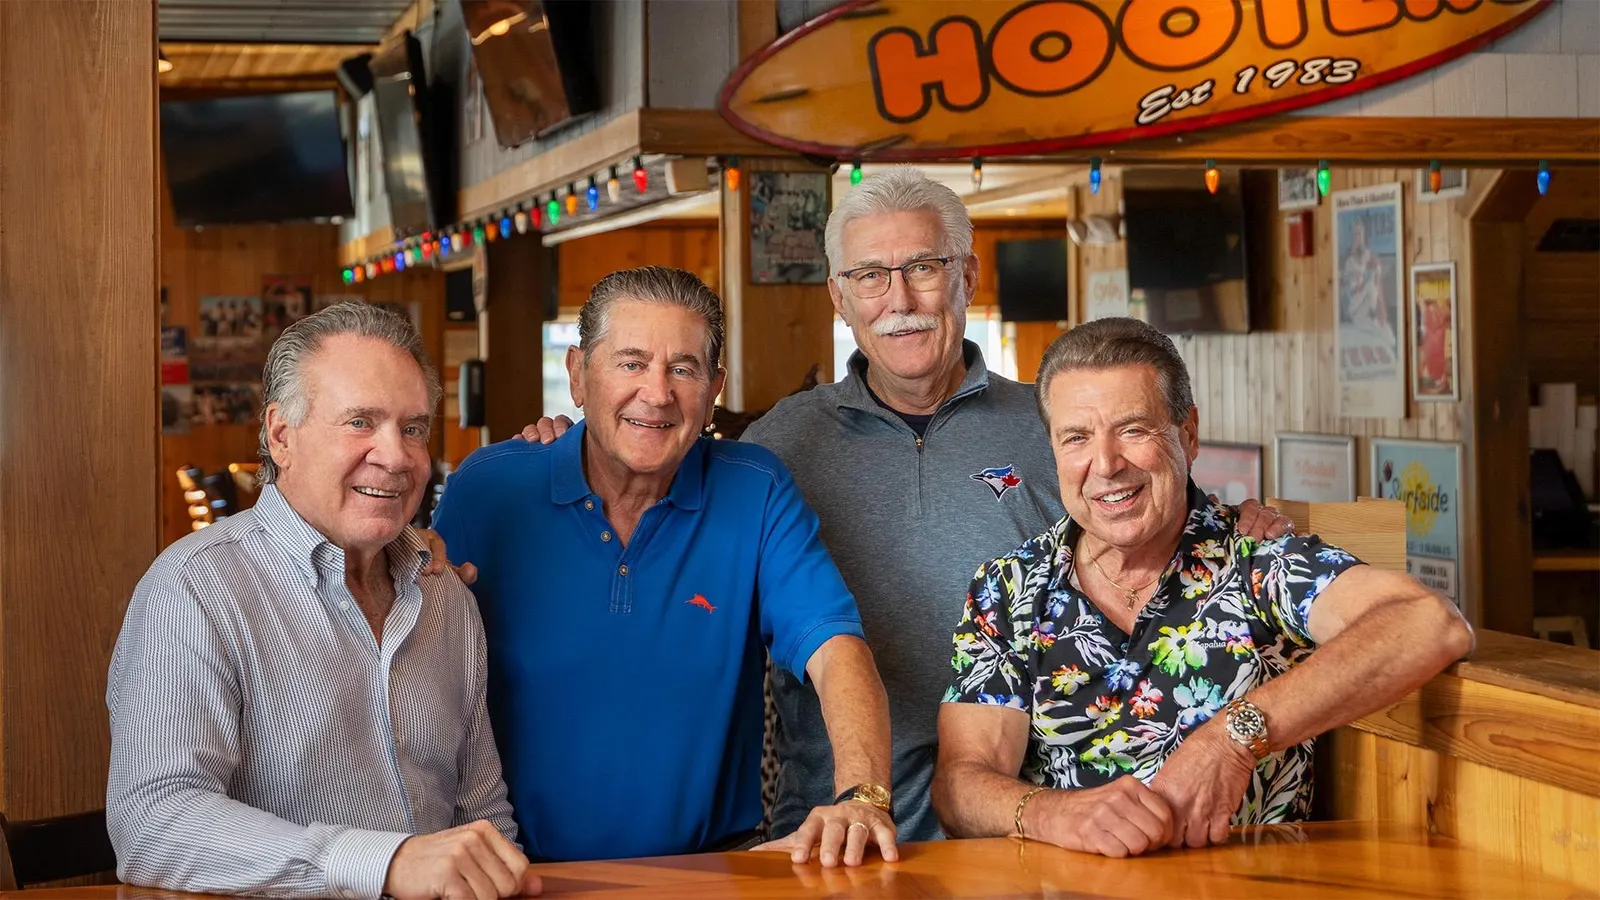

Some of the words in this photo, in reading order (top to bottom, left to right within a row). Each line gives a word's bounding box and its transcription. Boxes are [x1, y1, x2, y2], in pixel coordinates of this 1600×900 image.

[868, 0, 1526, 124] HOOT
[1135, 79, 1216, 125] Est
[1234, 58, 1361, 94] 1983
[1196, 640, 1226, 651] apalua
